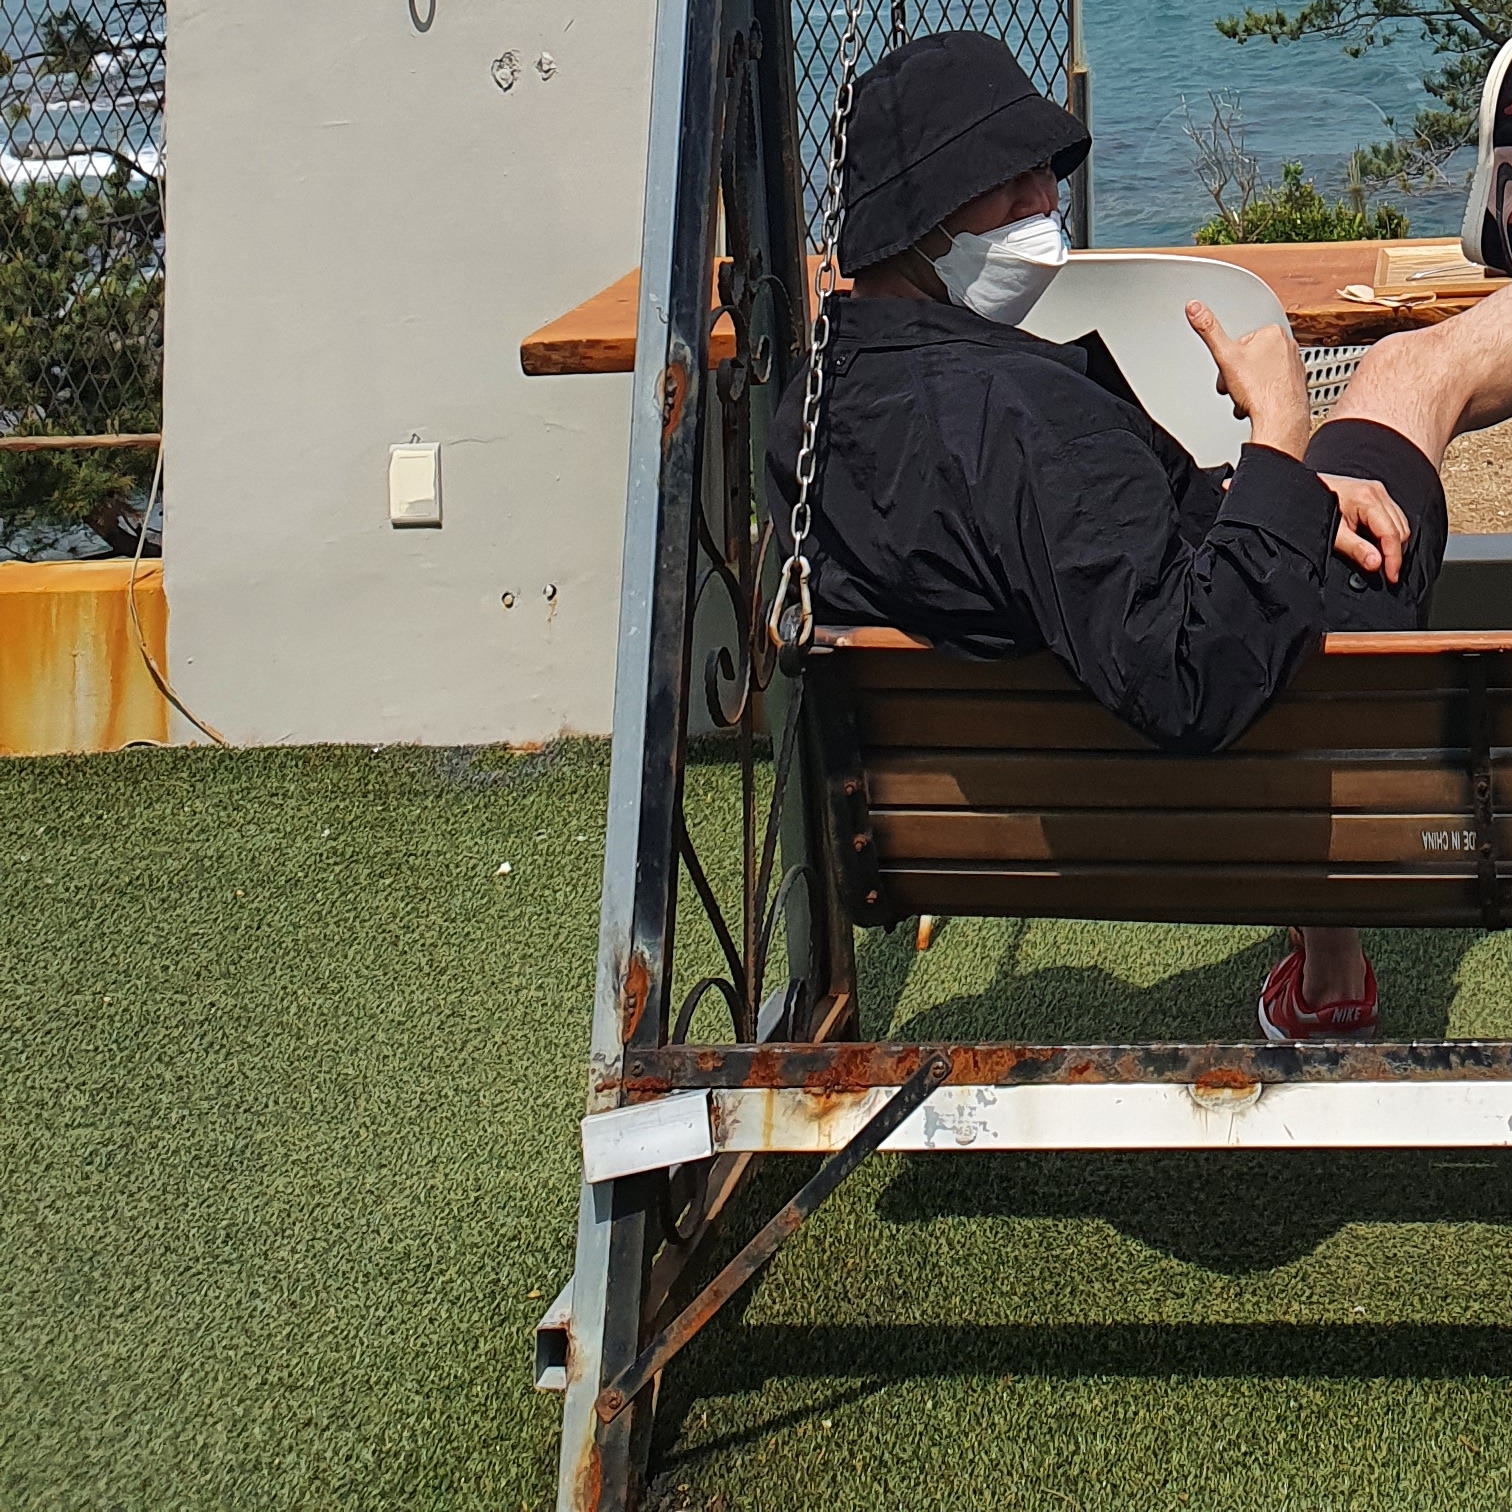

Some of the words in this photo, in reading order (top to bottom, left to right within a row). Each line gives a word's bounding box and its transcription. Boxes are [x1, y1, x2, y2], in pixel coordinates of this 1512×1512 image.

[1421, 830, 1449, 851] CHINA
[1451, 830, 1461, 851] IN
[1332, 1007, 1361, 1023] NIKE
